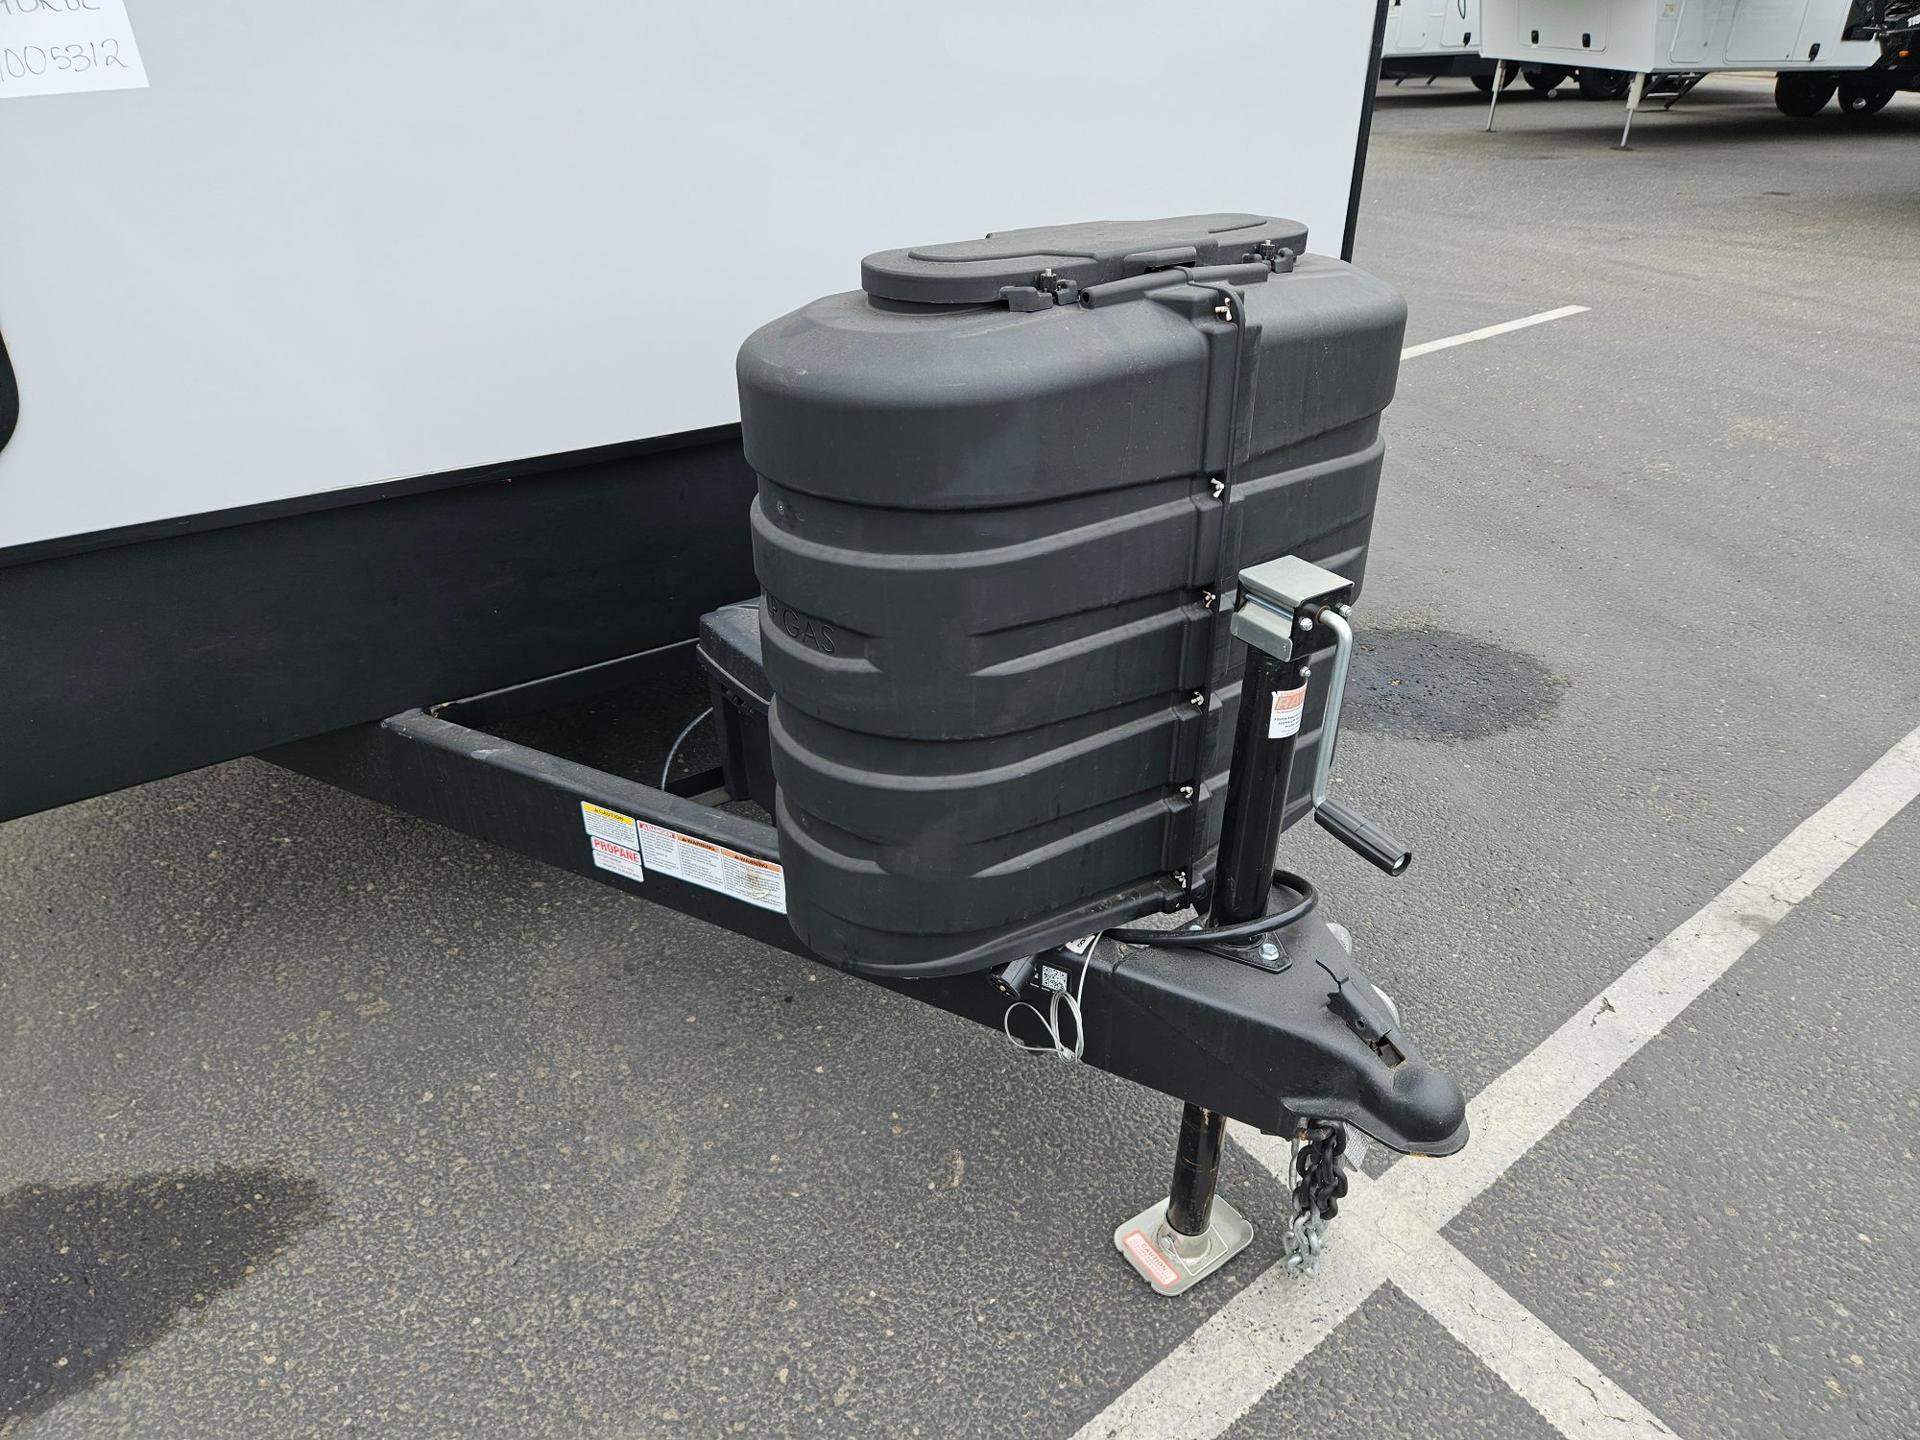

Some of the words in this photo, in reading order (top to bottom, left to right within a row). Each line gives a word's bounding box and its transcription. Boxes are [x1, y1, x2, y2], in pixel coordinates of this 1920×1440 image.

[0, 38, 128, 82] 005312
[782, 608, 835, 654] GAS
[598, 808, 624, 822] CAUTION
[594, 839, 640, 863] PROPANE
[686, 839, 715, 852] WARNING
[739, 856, 769, 869] WARNING
